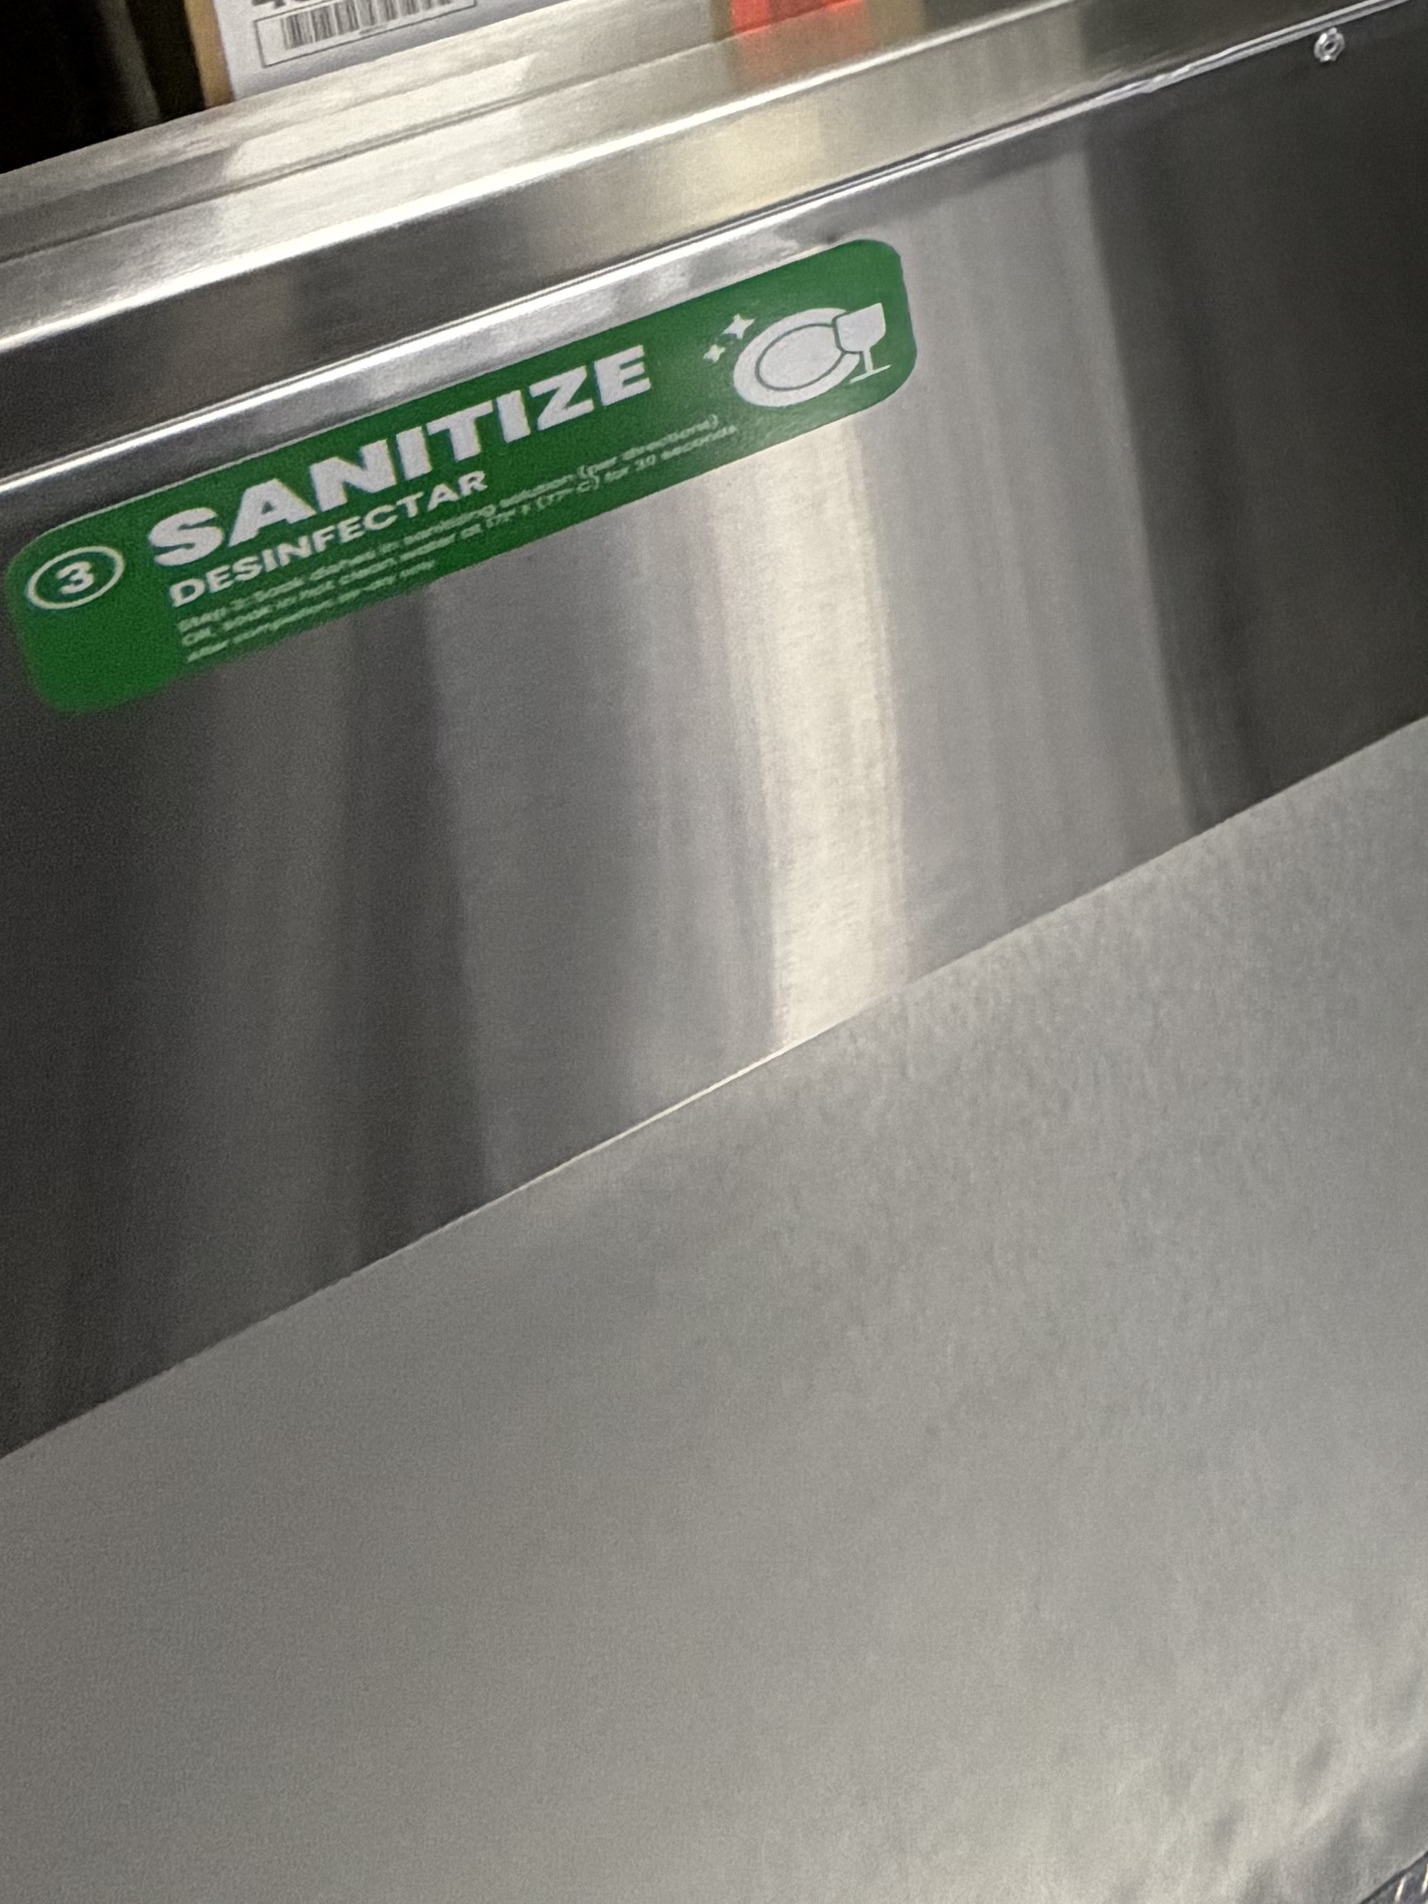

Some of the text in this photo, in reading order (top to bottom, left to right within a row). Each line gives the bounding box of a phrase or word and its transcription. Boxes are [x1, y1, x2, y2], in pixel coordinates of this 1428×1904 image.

[147, 344, 652, 569] SANITIZE
[58, 561, 96, 597] 3
[169, 471, 490, 609] DESINFECTAR
